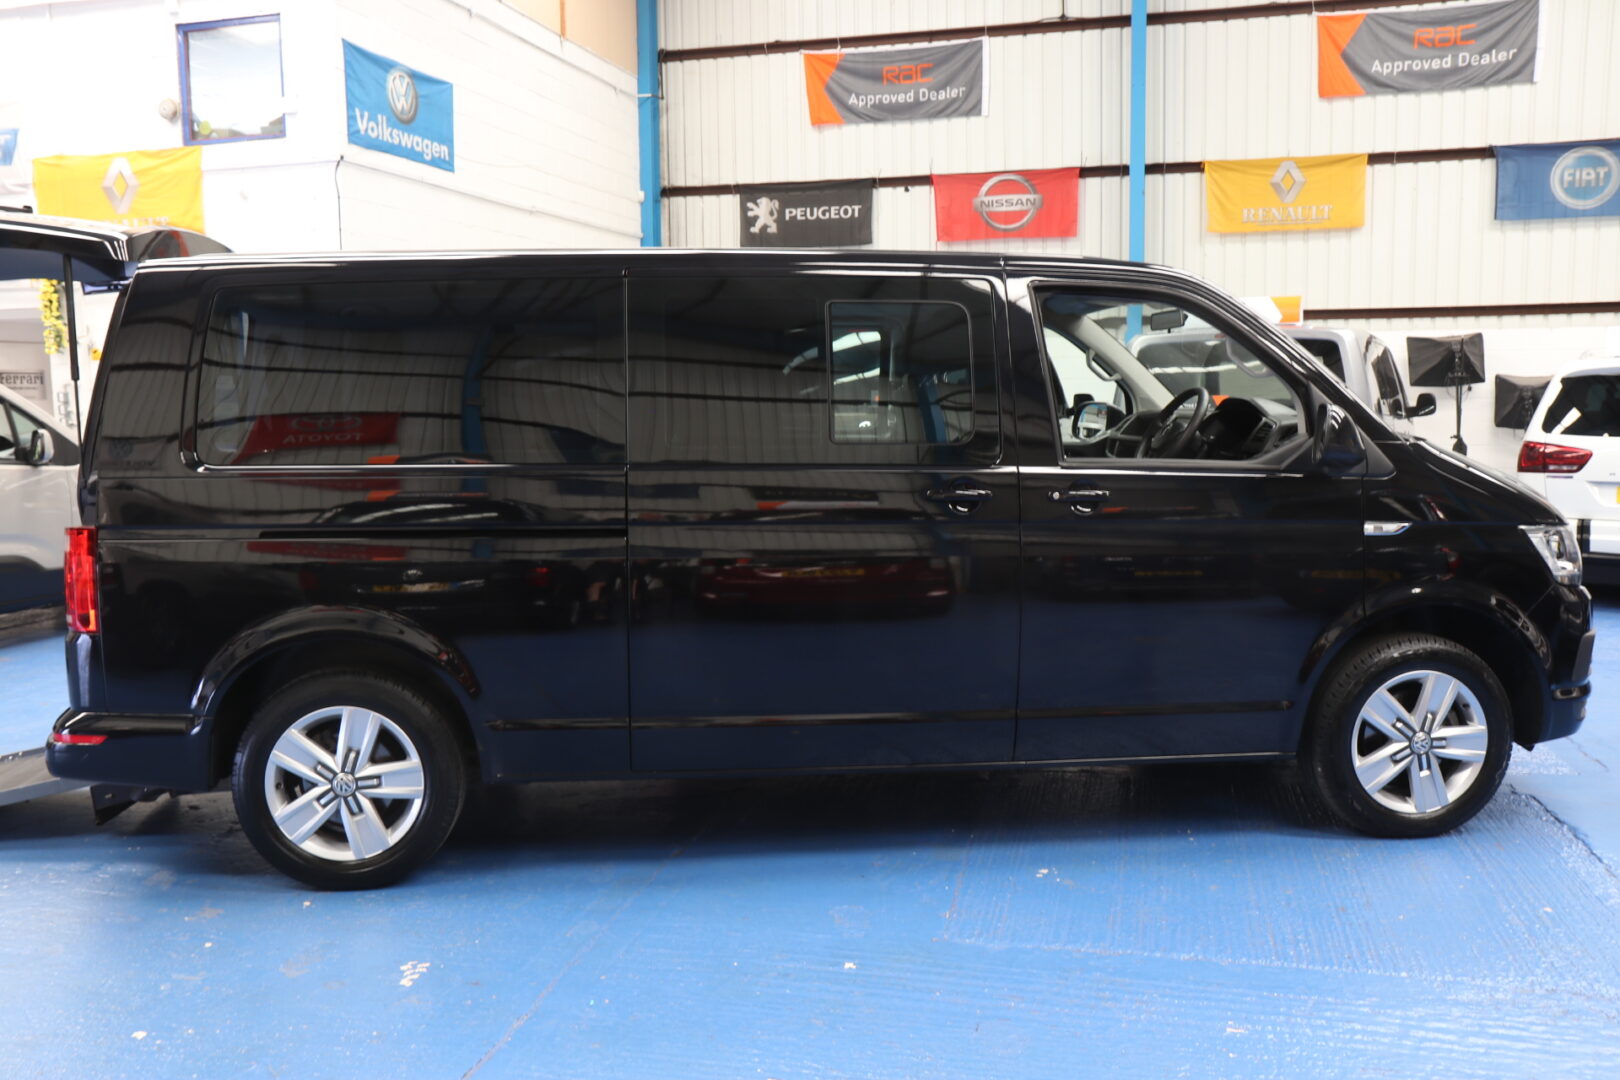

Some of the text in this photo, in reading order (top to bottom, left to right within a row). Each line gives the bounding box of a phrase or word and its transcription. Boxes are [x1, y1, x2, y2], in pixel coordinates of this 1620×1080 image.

[1371, 49, 1518, 76] Approved Dealer
[849, 86, 966, 108] Approved Dealer
[355, 107, 449, 161] Volkswagen
[1563, 166, 1609, 189] FIAT
[784, 204, 862, 221] PEUGEOT
[979, 196, 1037, 210] NISSAN
[1241, 205, 1333, 224] RENAULT
